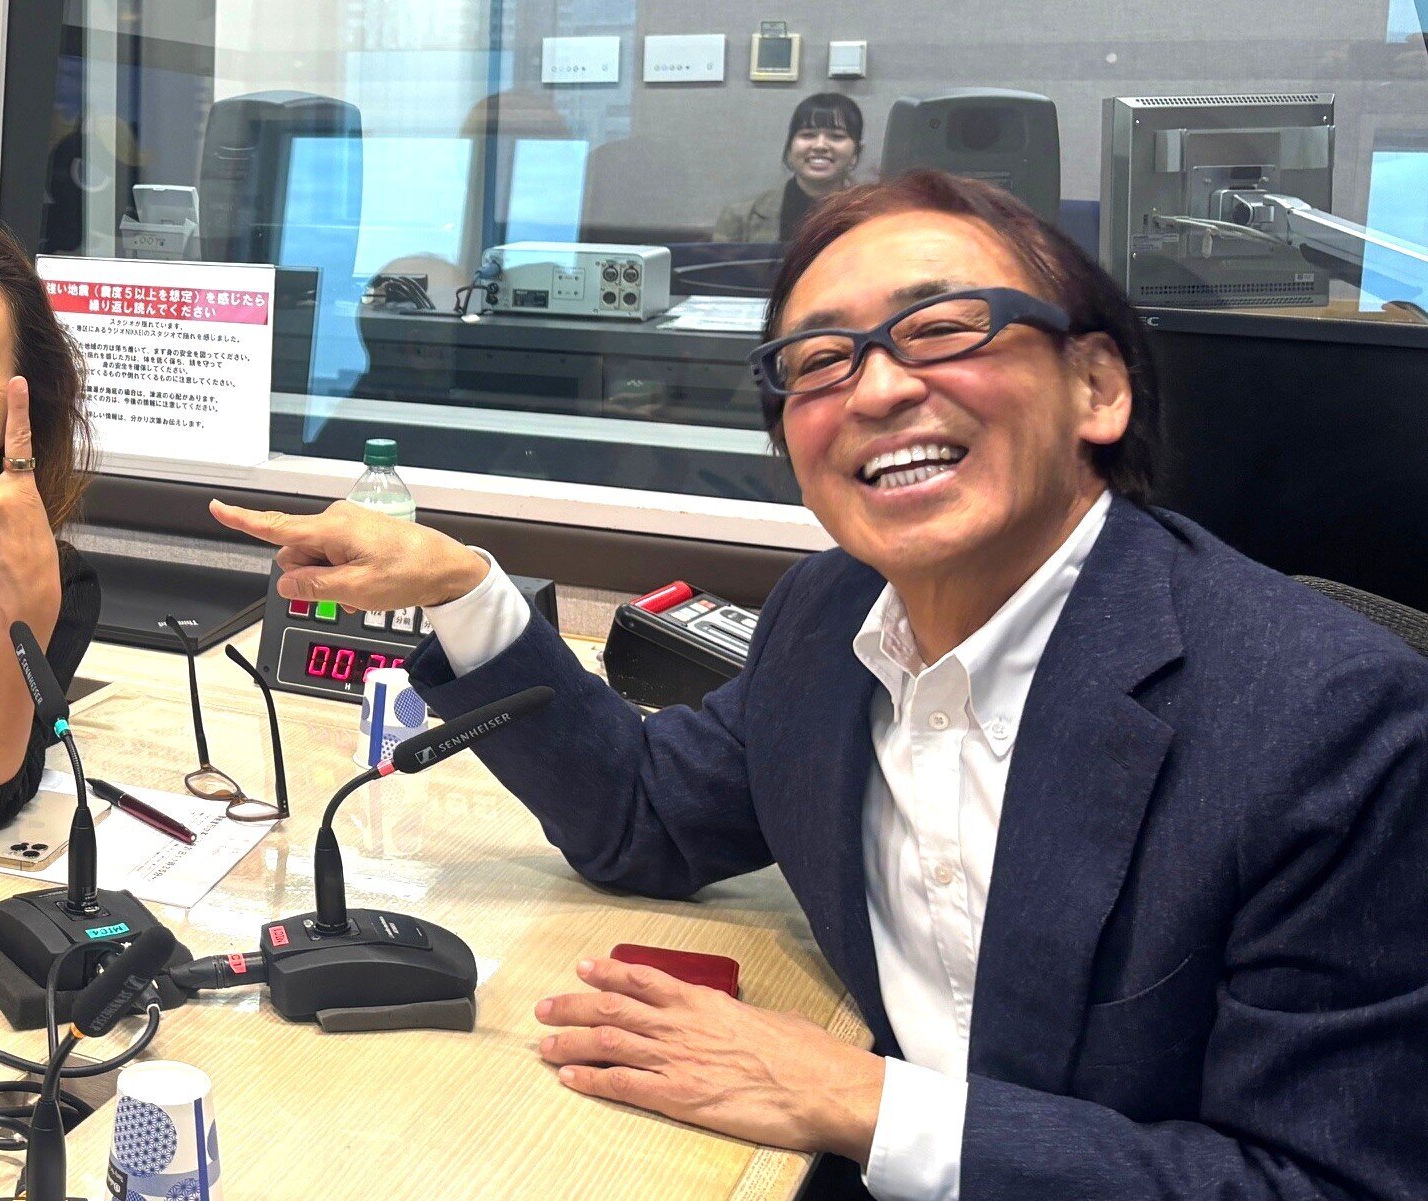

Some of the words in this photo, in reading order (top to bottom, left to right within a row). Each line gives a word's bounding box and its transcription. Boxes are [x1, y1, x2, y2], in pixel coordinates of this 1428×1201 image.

[88, 299, 216, 319] 繰り返し読んでください
[21, 658, 44, 705] SENNHEISER
[344, 682, 351, 691] H
[438, 712, 512, 753] SENNHEISER
[92, 924, 124, 936] MIC4
